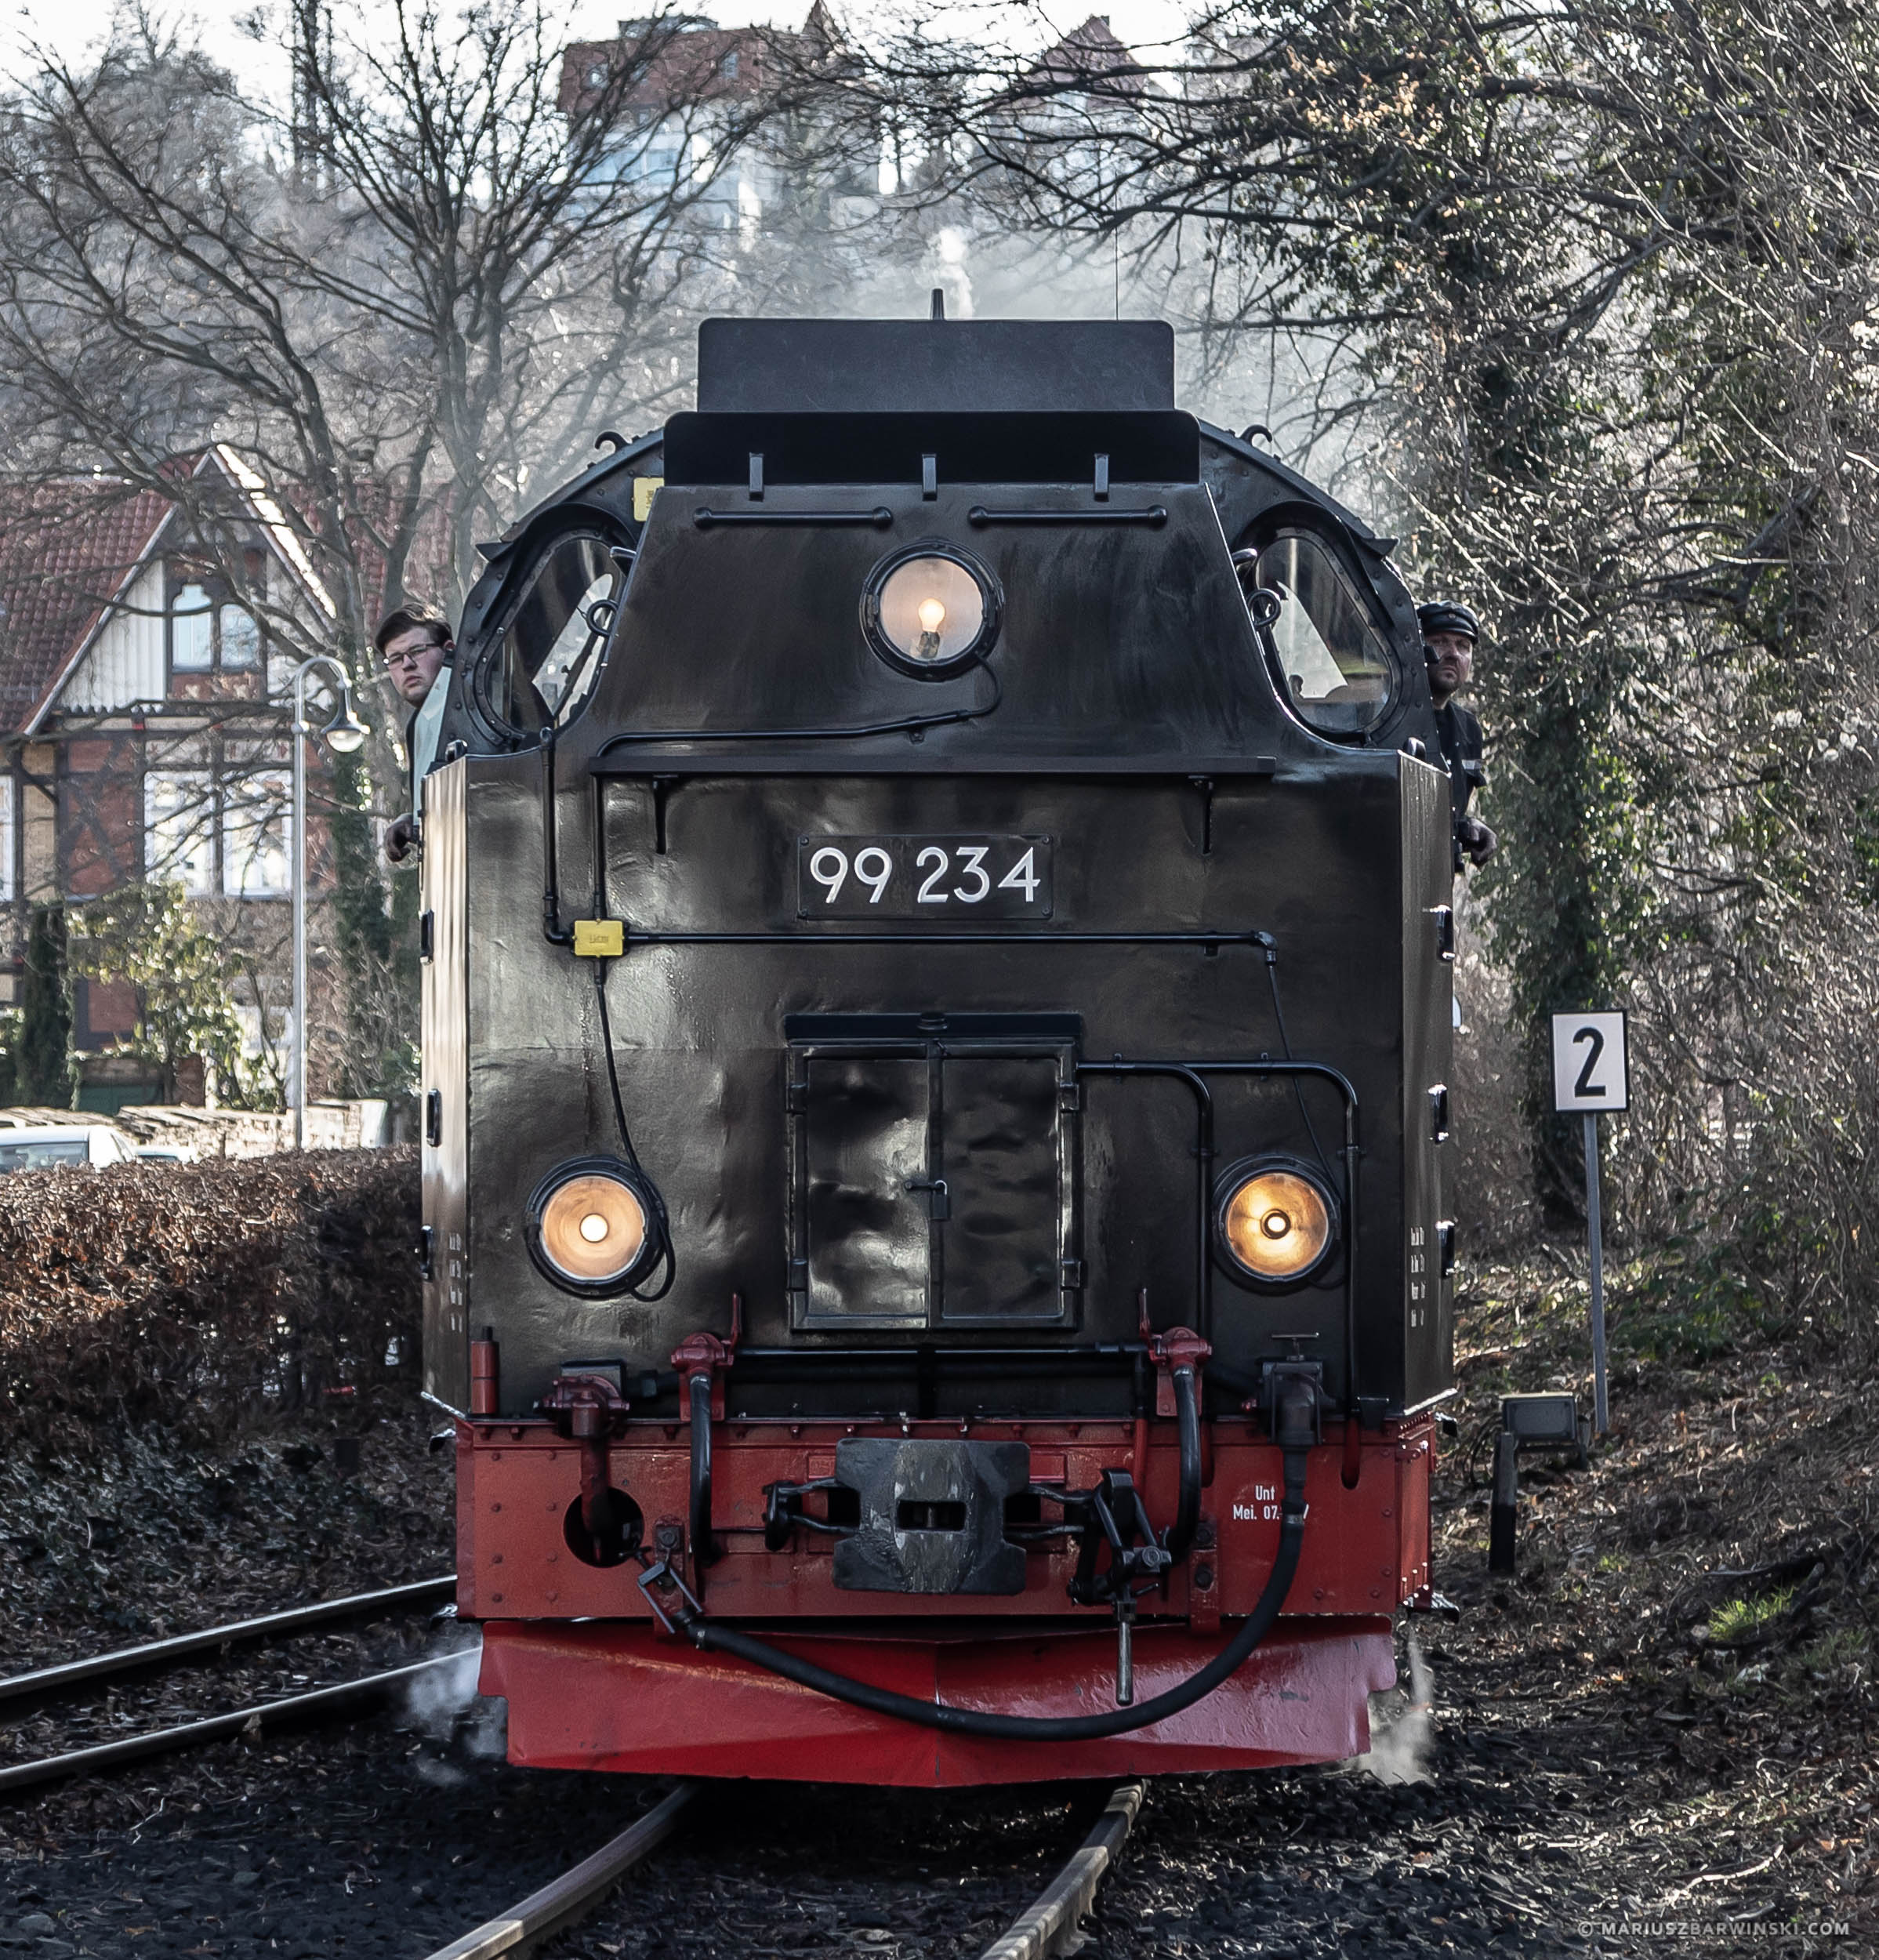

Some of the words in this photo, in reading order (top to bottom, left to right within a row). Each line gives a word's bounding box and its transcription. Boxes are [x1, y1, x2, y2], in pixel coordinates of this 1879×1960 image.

[810, 847, 892, 903] 99
[916, 846, 1041, 903] 234
[1572, 1027, 1604, 1098] 2
[1255, 1485, 1275, 1501] Unt
[1232, 1504, 1257, 1520] Mei.
